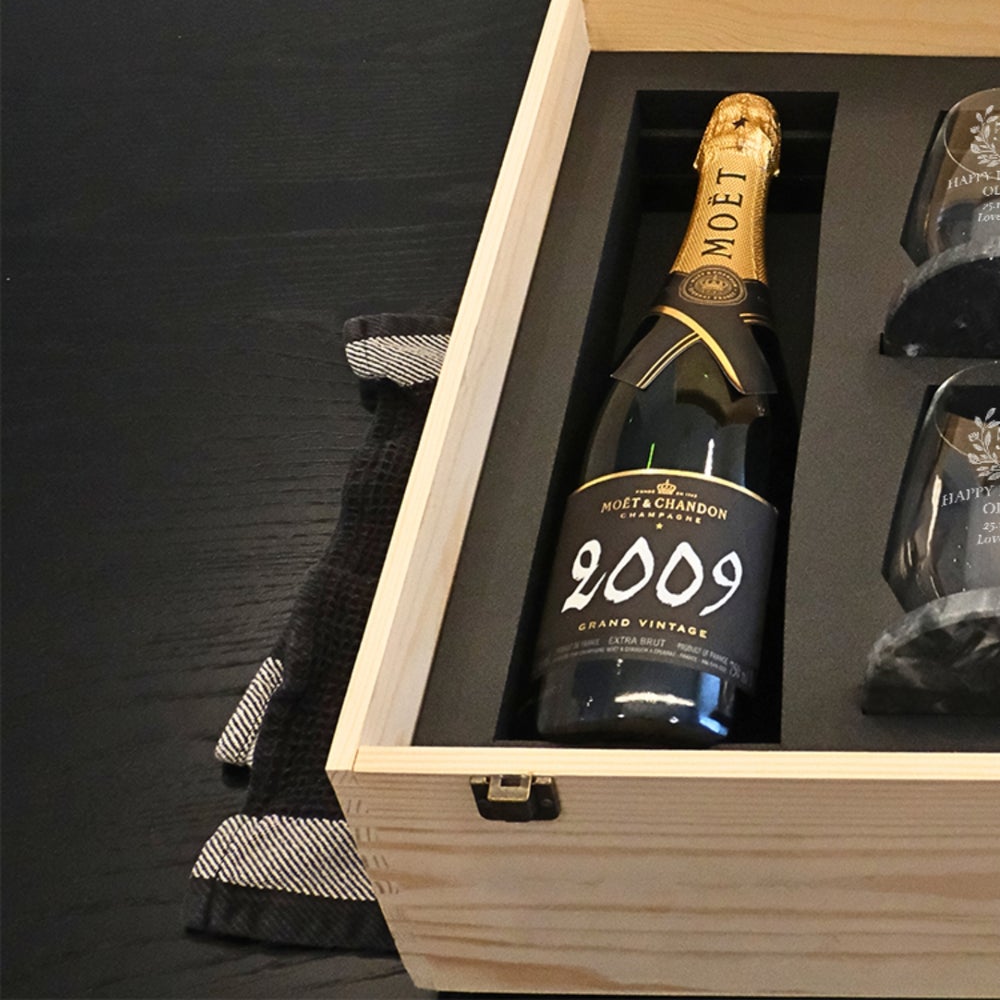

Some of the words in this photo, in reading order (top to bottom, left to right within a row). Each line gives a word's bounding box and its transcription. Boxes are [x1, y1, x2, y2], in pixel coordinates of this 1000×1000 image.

[701, 167, 747, 259] MOËT
[941, 485, 994, 507] HAPPY
[619, 512, 702, 525] CHAMPAGNE
[642, 499, 652, 509] &
[654, 497, 728, 521] CHANDON
[561, 536, 743, 617] 2009
[577, 618, 631, 632] GRAND
[638, 618, 708, 640] VINTAGE
[608, 636, 638, 646] EXTRA
[639, 637, 666, 648] BRUT
